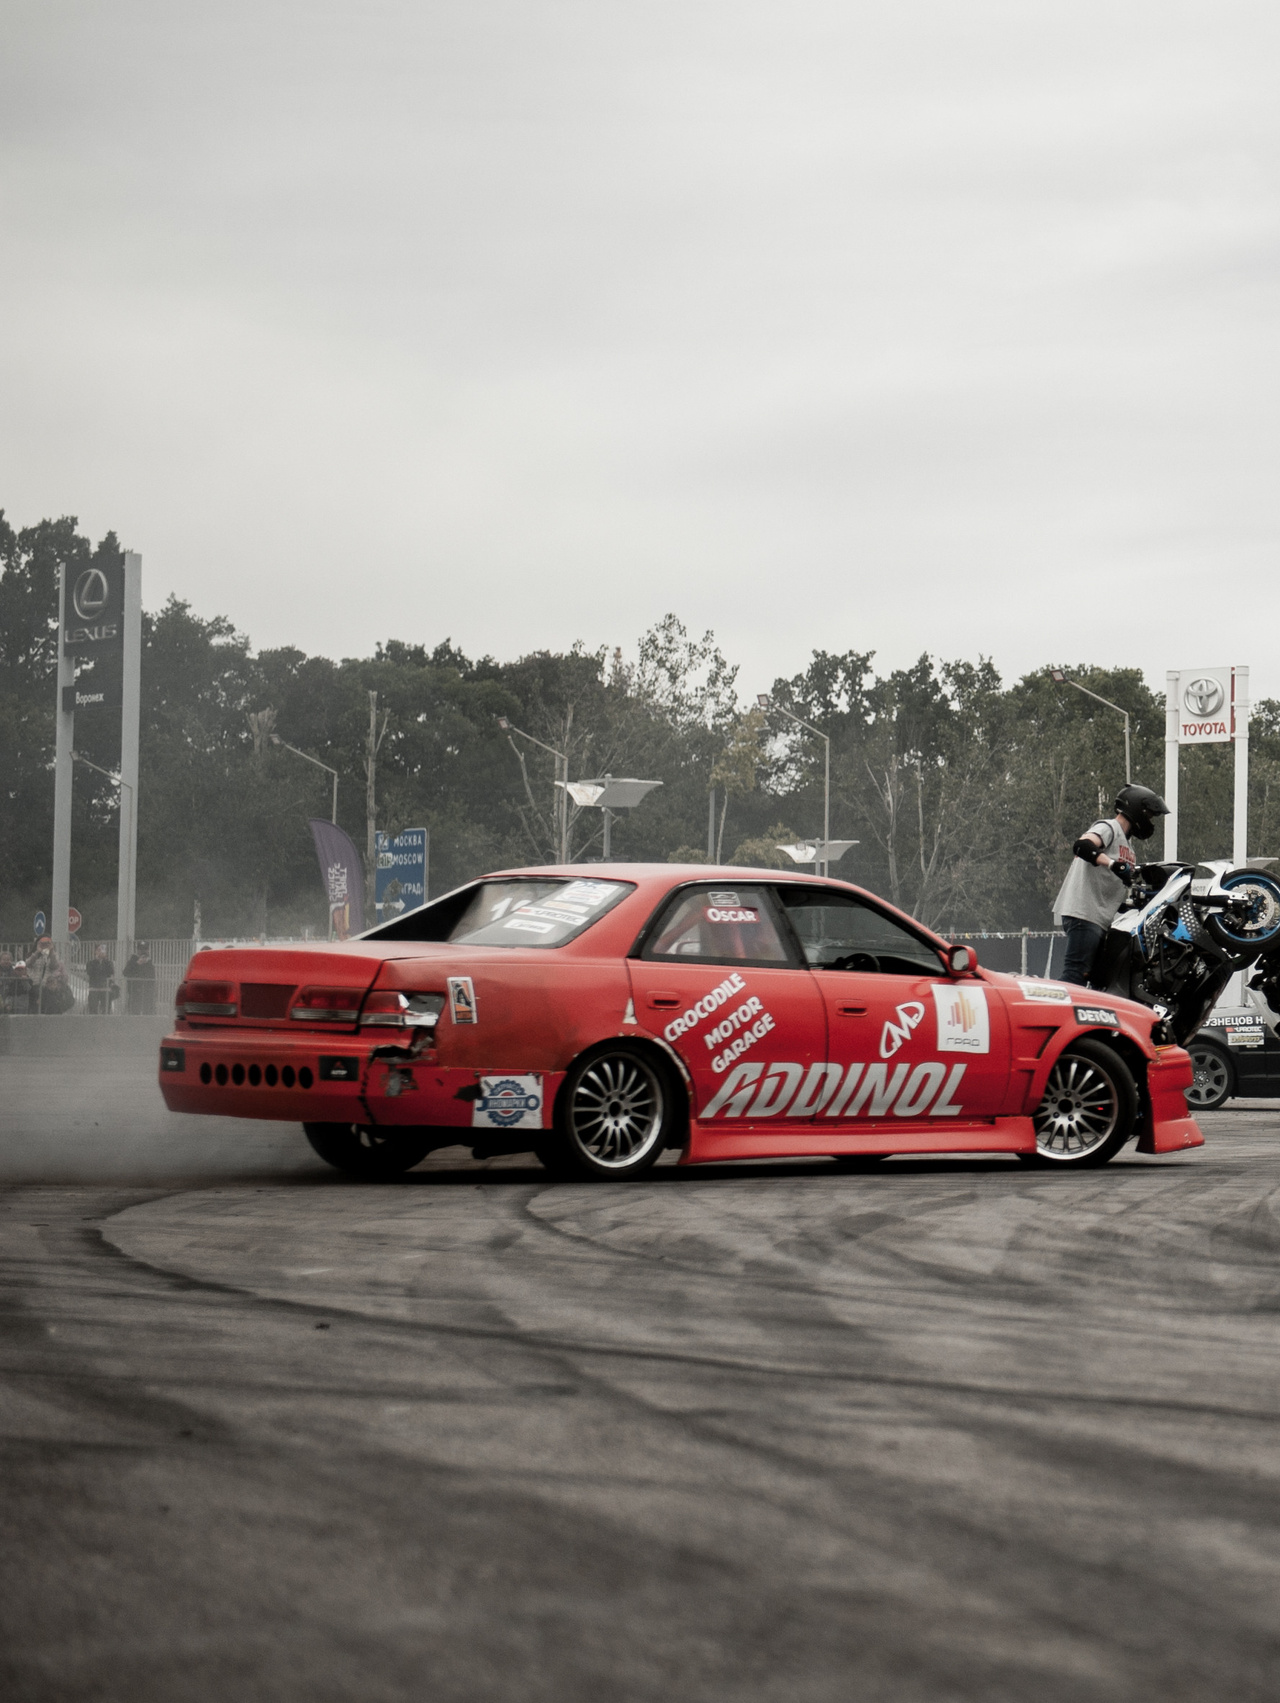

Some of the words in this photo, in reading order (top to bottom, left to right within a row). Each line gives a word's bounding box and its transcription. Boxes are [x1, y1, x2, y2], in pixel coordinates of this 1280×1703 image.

[65, 624, 117, 643] LEXUS
[1182, 722, 1227, 736] TOYOTA
[394, 834, 423, 848] МОСКВА
[392, 852, 424, 866] MOSCOW
[69, 916, 79, 925] OP
[707, 908, 757, 922] OSCAR
[663, 972, 746, 1043] CROCODILE
[703, 996, 764, 1050] MOTOR
[1203, 1016, 1253, 1027] УЗНЕЦОВ
[711, 1013, 775, 1073] GARAGE
[699, 1062, 967, 1118] ADDINOL
